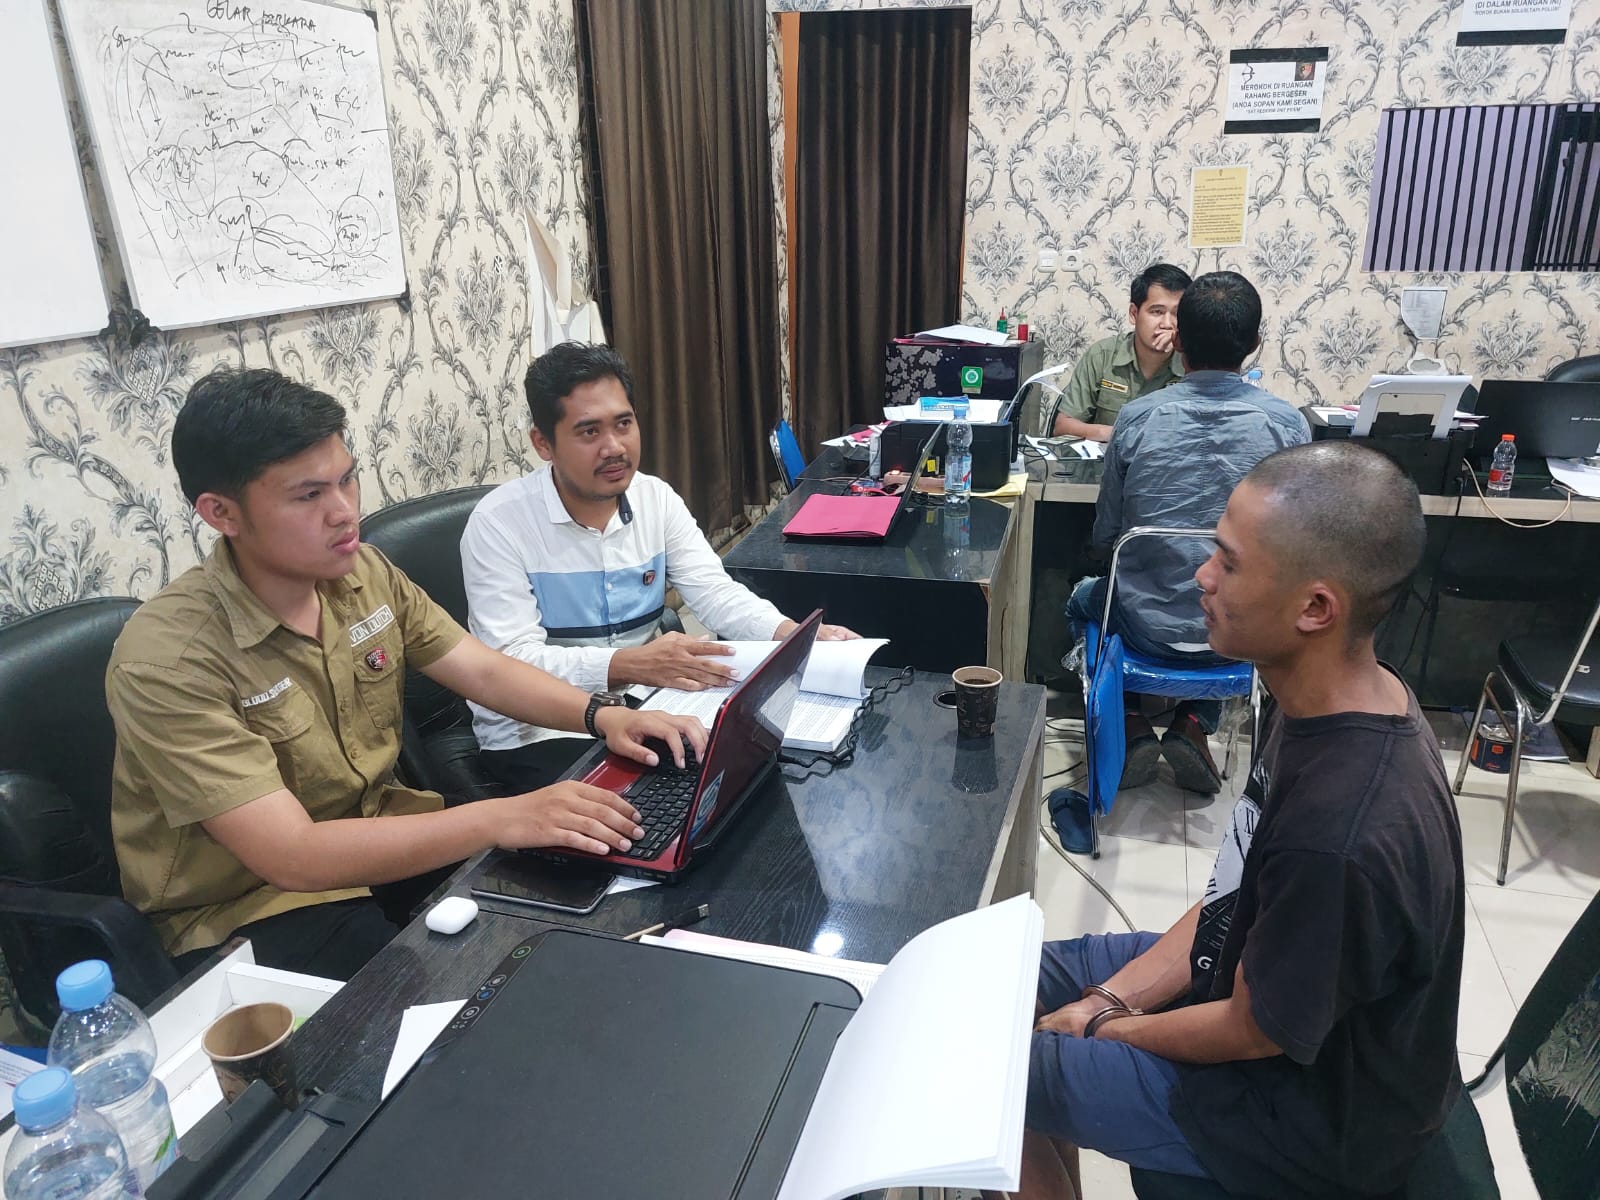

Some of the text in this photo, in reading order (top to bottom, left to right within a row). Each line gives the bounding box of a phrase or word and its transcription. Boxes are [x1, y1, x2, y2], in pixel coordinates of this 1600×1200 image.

[1486, 0, 1511, 8] DALAM
[1240, 83, 1272, 91] MEROKOK
[1281, 81, 1314, 89] RUANGAN
[1244, 90, 1308, 99] RAHANG BERGESER
[1253, 100, 1275, 108] SOPAN
[1276, 99, 1293, 107] KAMI
[349, 623, 370, 643] VON
